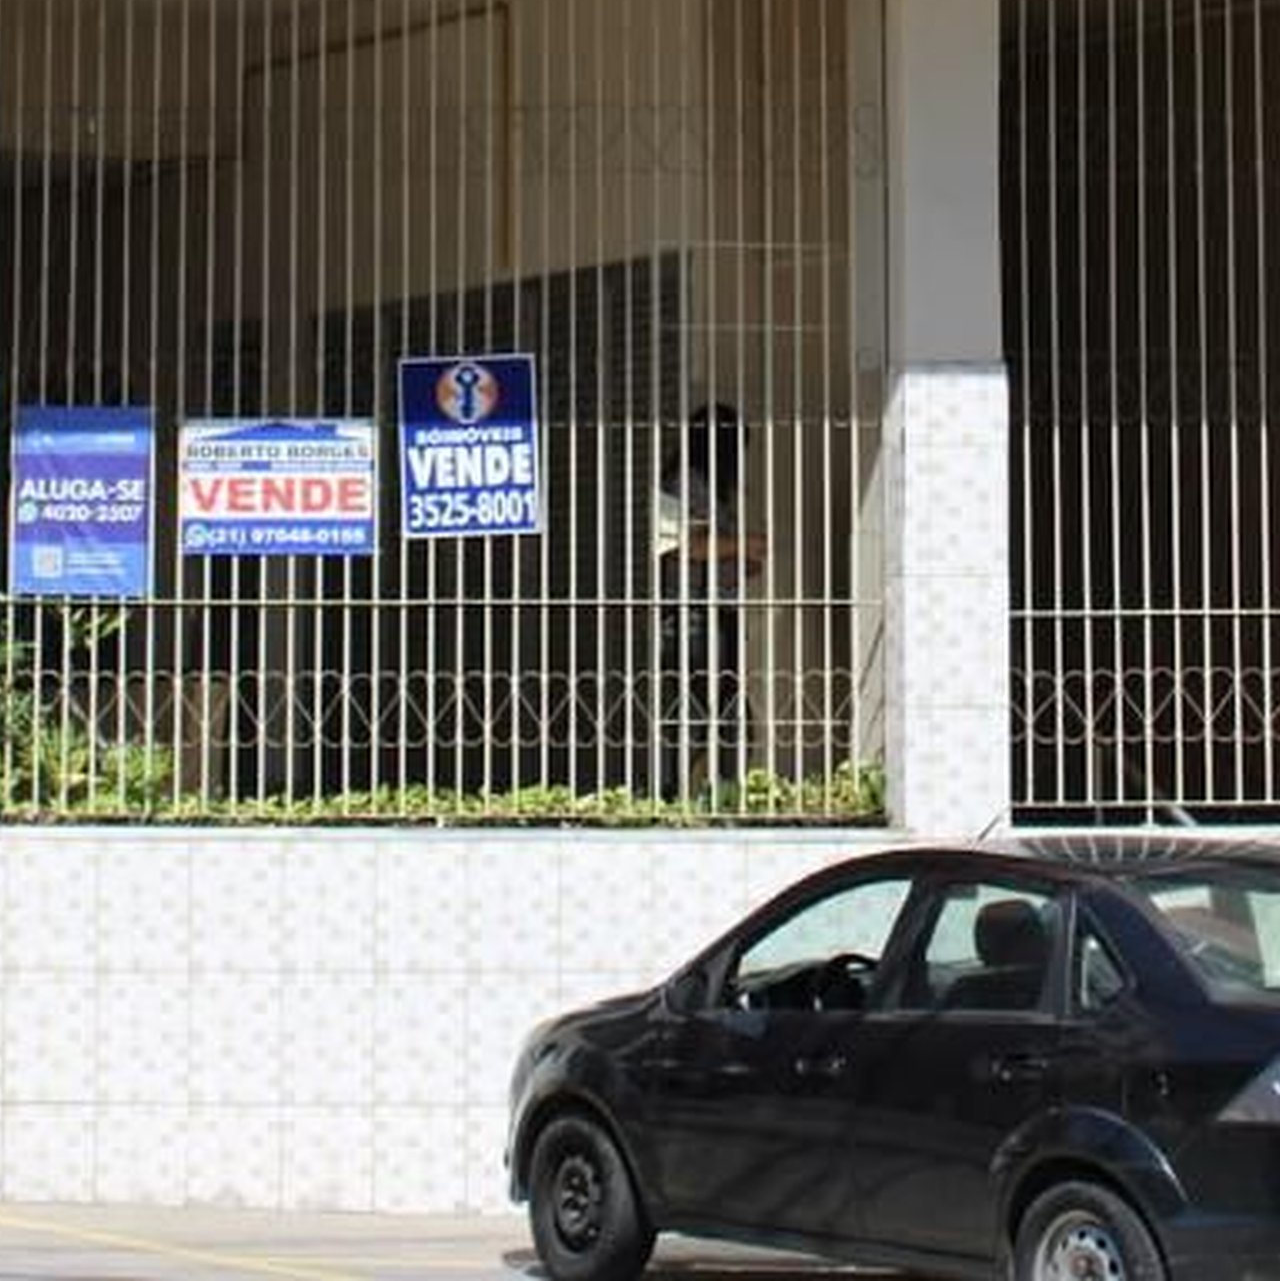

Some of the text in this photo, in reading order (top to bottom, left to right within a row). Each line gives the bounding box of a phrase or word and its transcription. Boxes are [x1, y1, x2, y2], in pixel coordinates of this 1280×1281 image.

[407, 442, 533, 491] VENDE
[20, 478, 145, 501] ALUGA-SE
[188, 475, 368, 513] VENDE
[410, 489, 535, 529] 3525-8001
